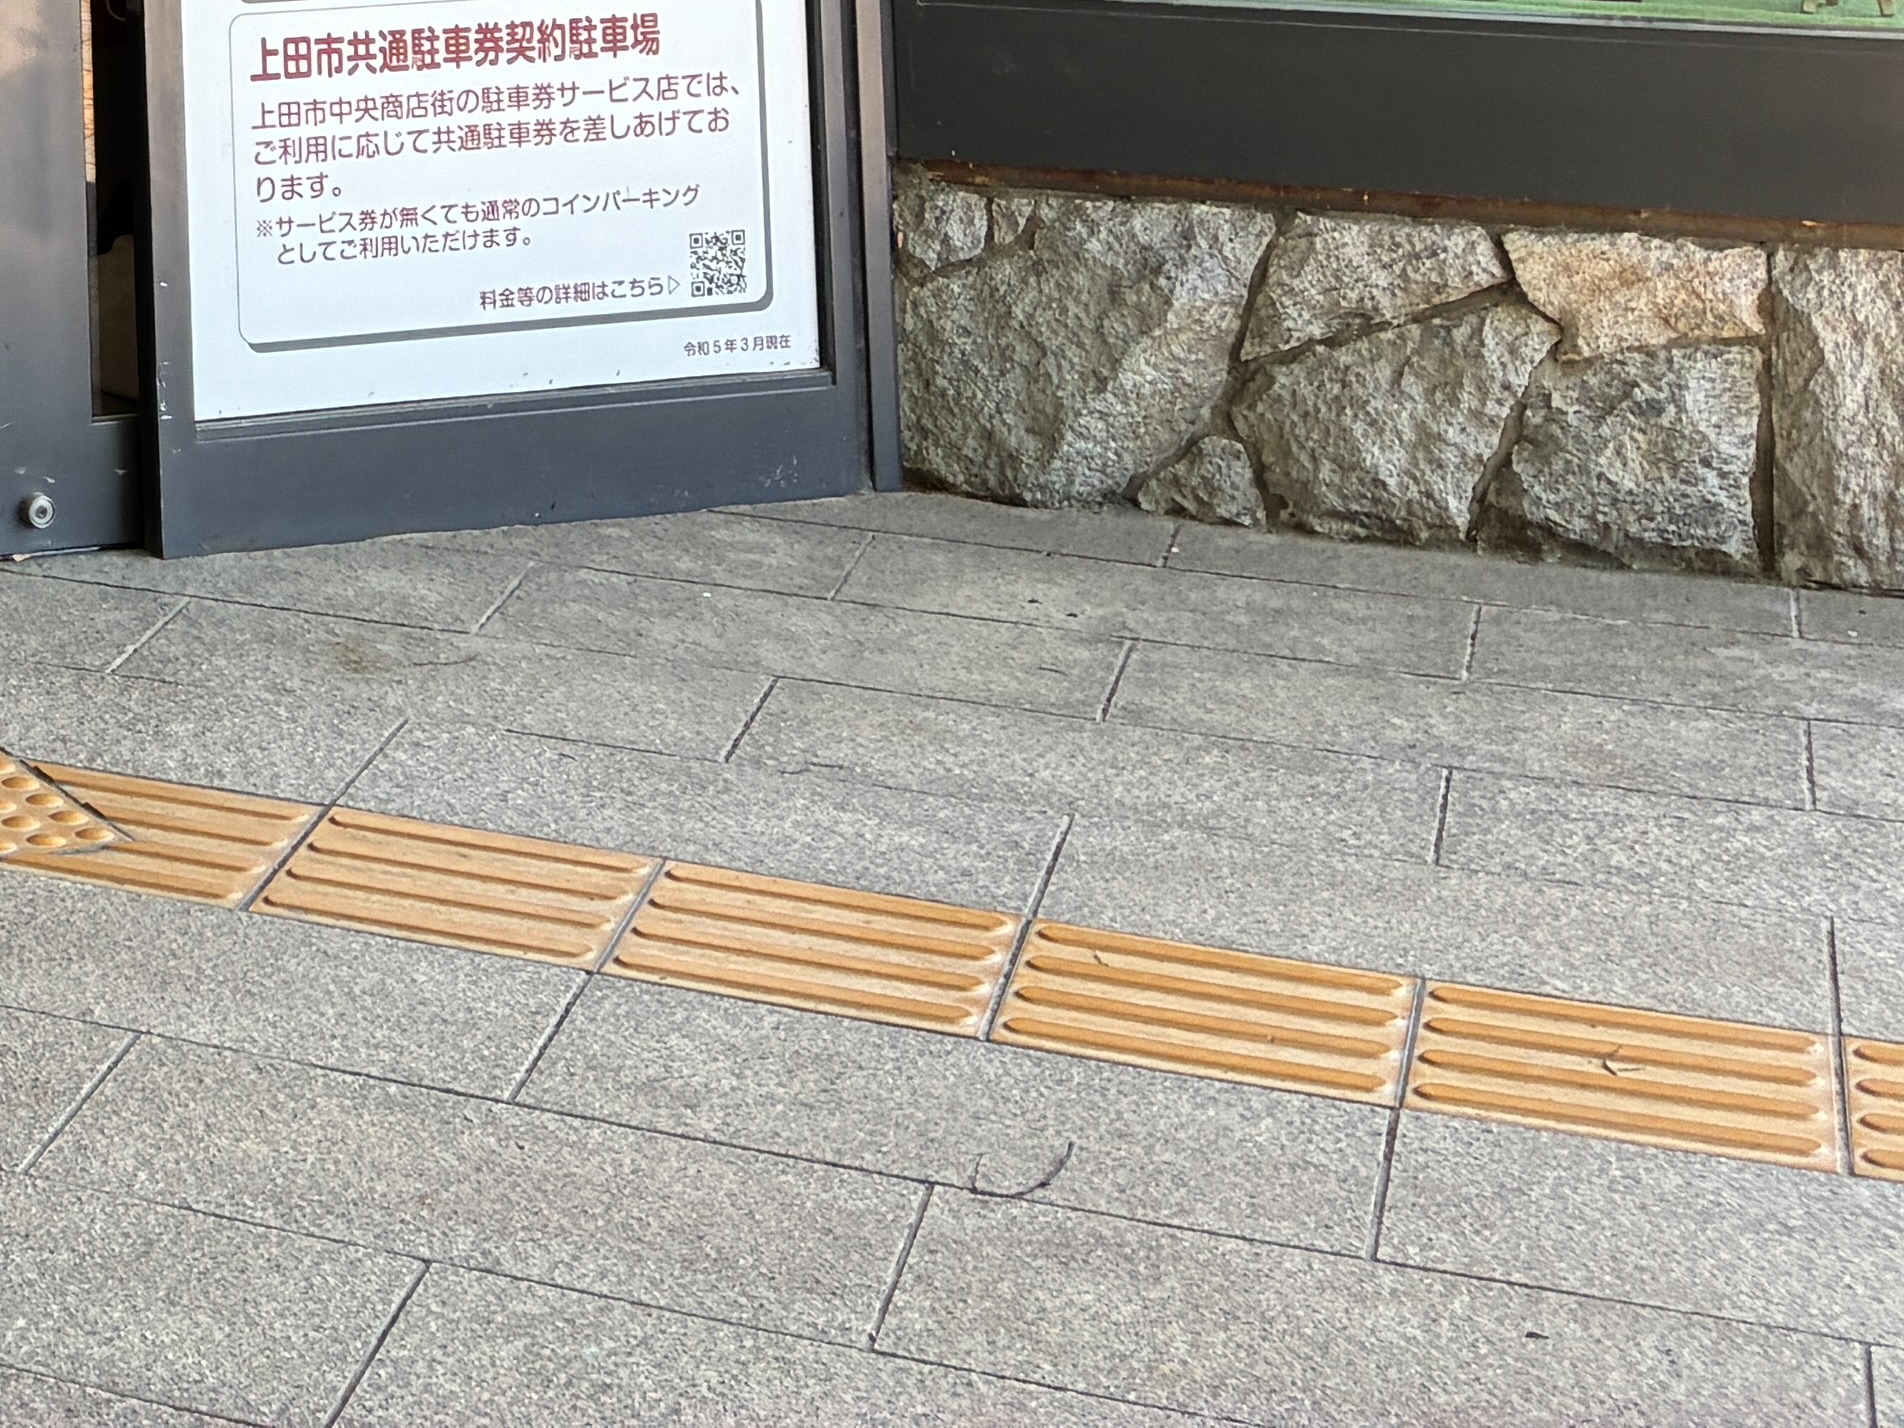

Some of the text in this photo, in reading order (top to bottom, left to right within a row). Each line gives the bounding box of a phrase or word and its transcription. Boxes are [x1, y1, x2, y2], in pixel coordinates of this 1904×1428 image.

[250, 14, 660, 82] 上田市共通駐車券契約駐車場
[480, 275, 663, 311] 料金等の詳細はこちら
